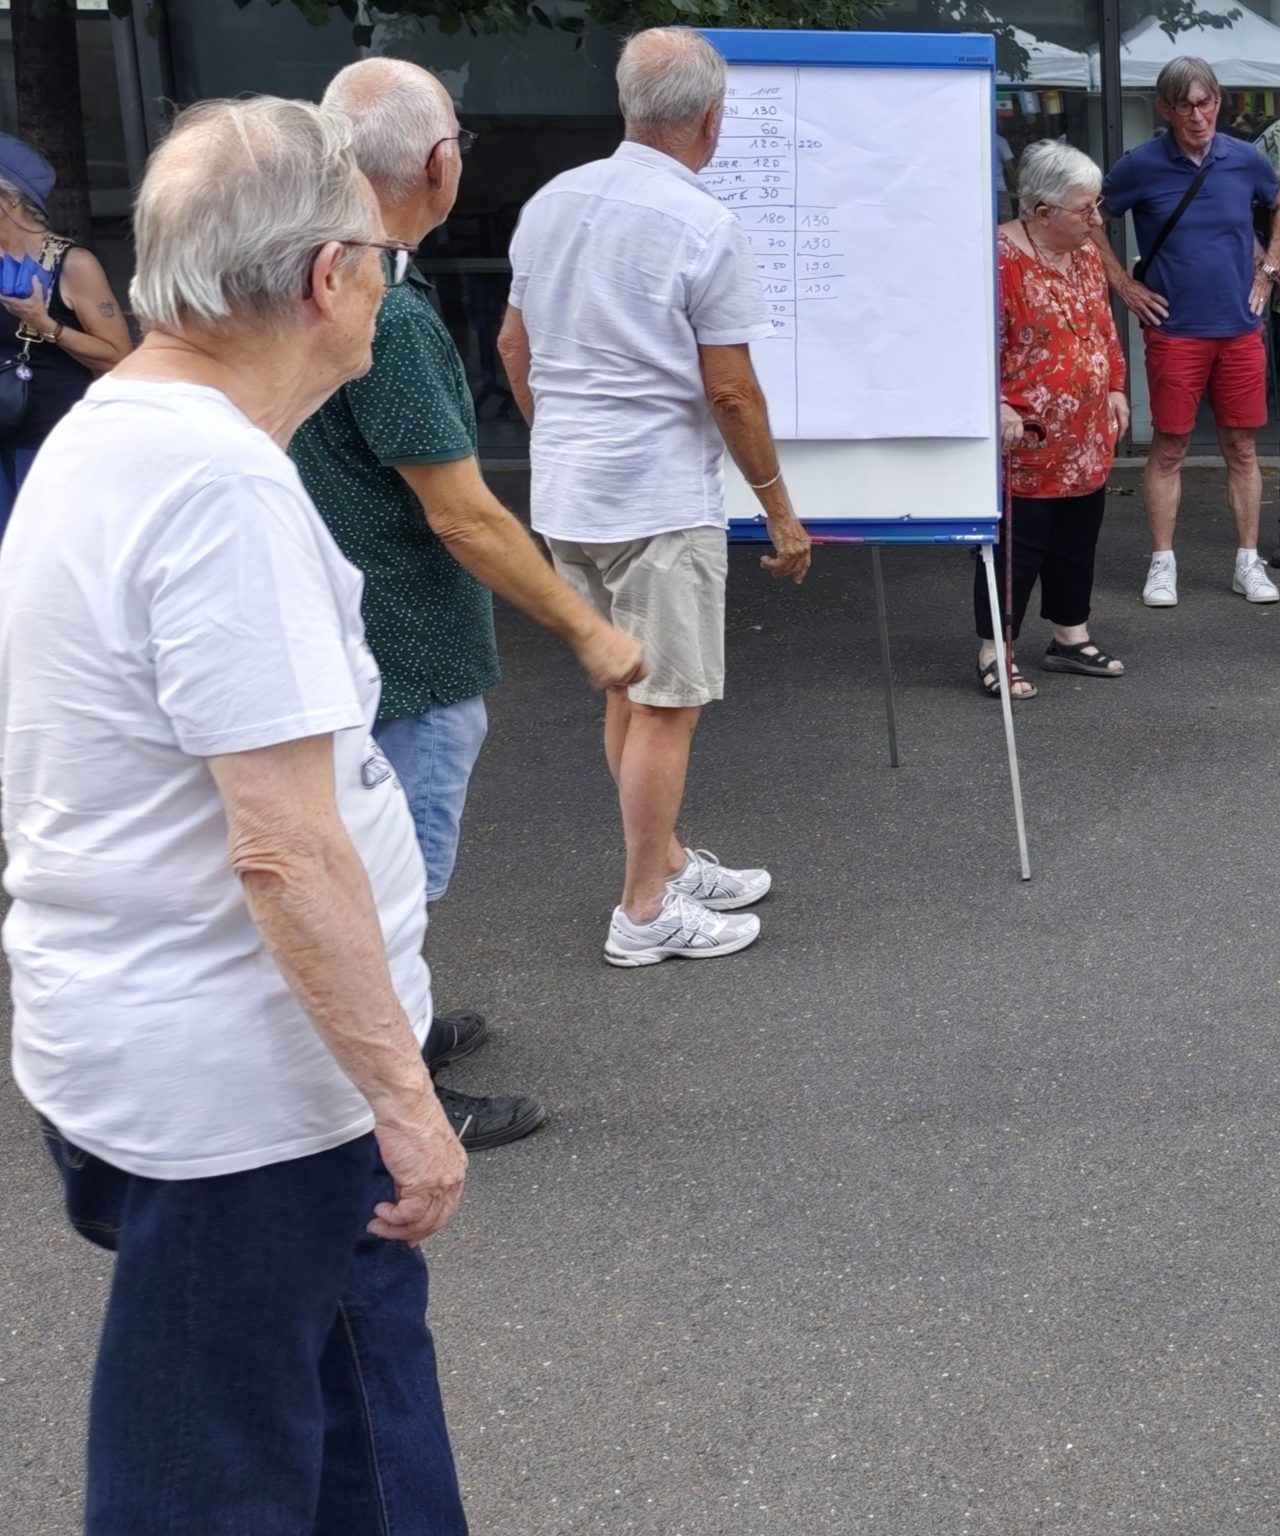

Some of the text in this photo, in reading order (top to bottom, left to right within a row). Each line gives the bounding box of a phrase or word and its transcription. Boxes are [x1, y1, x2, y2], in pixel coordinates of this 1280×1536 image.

[751, 105, 778, 116] 130
[760, 122, 779, 135] 60
[749, 138, 779, 149] 120
[797, 141, 823, 149] 220
[753, 157, 781, 168] 120
[760, 174, 781, 183] 50
[758, 187, 779, 200] 30
[756, 212, 786, 224] 180
[800, 214, 830, 228] 130
[767, 238, 831, 249] 70 130
[771, 262, 787, 271] 50
[771, 304, 786, 312] 70
